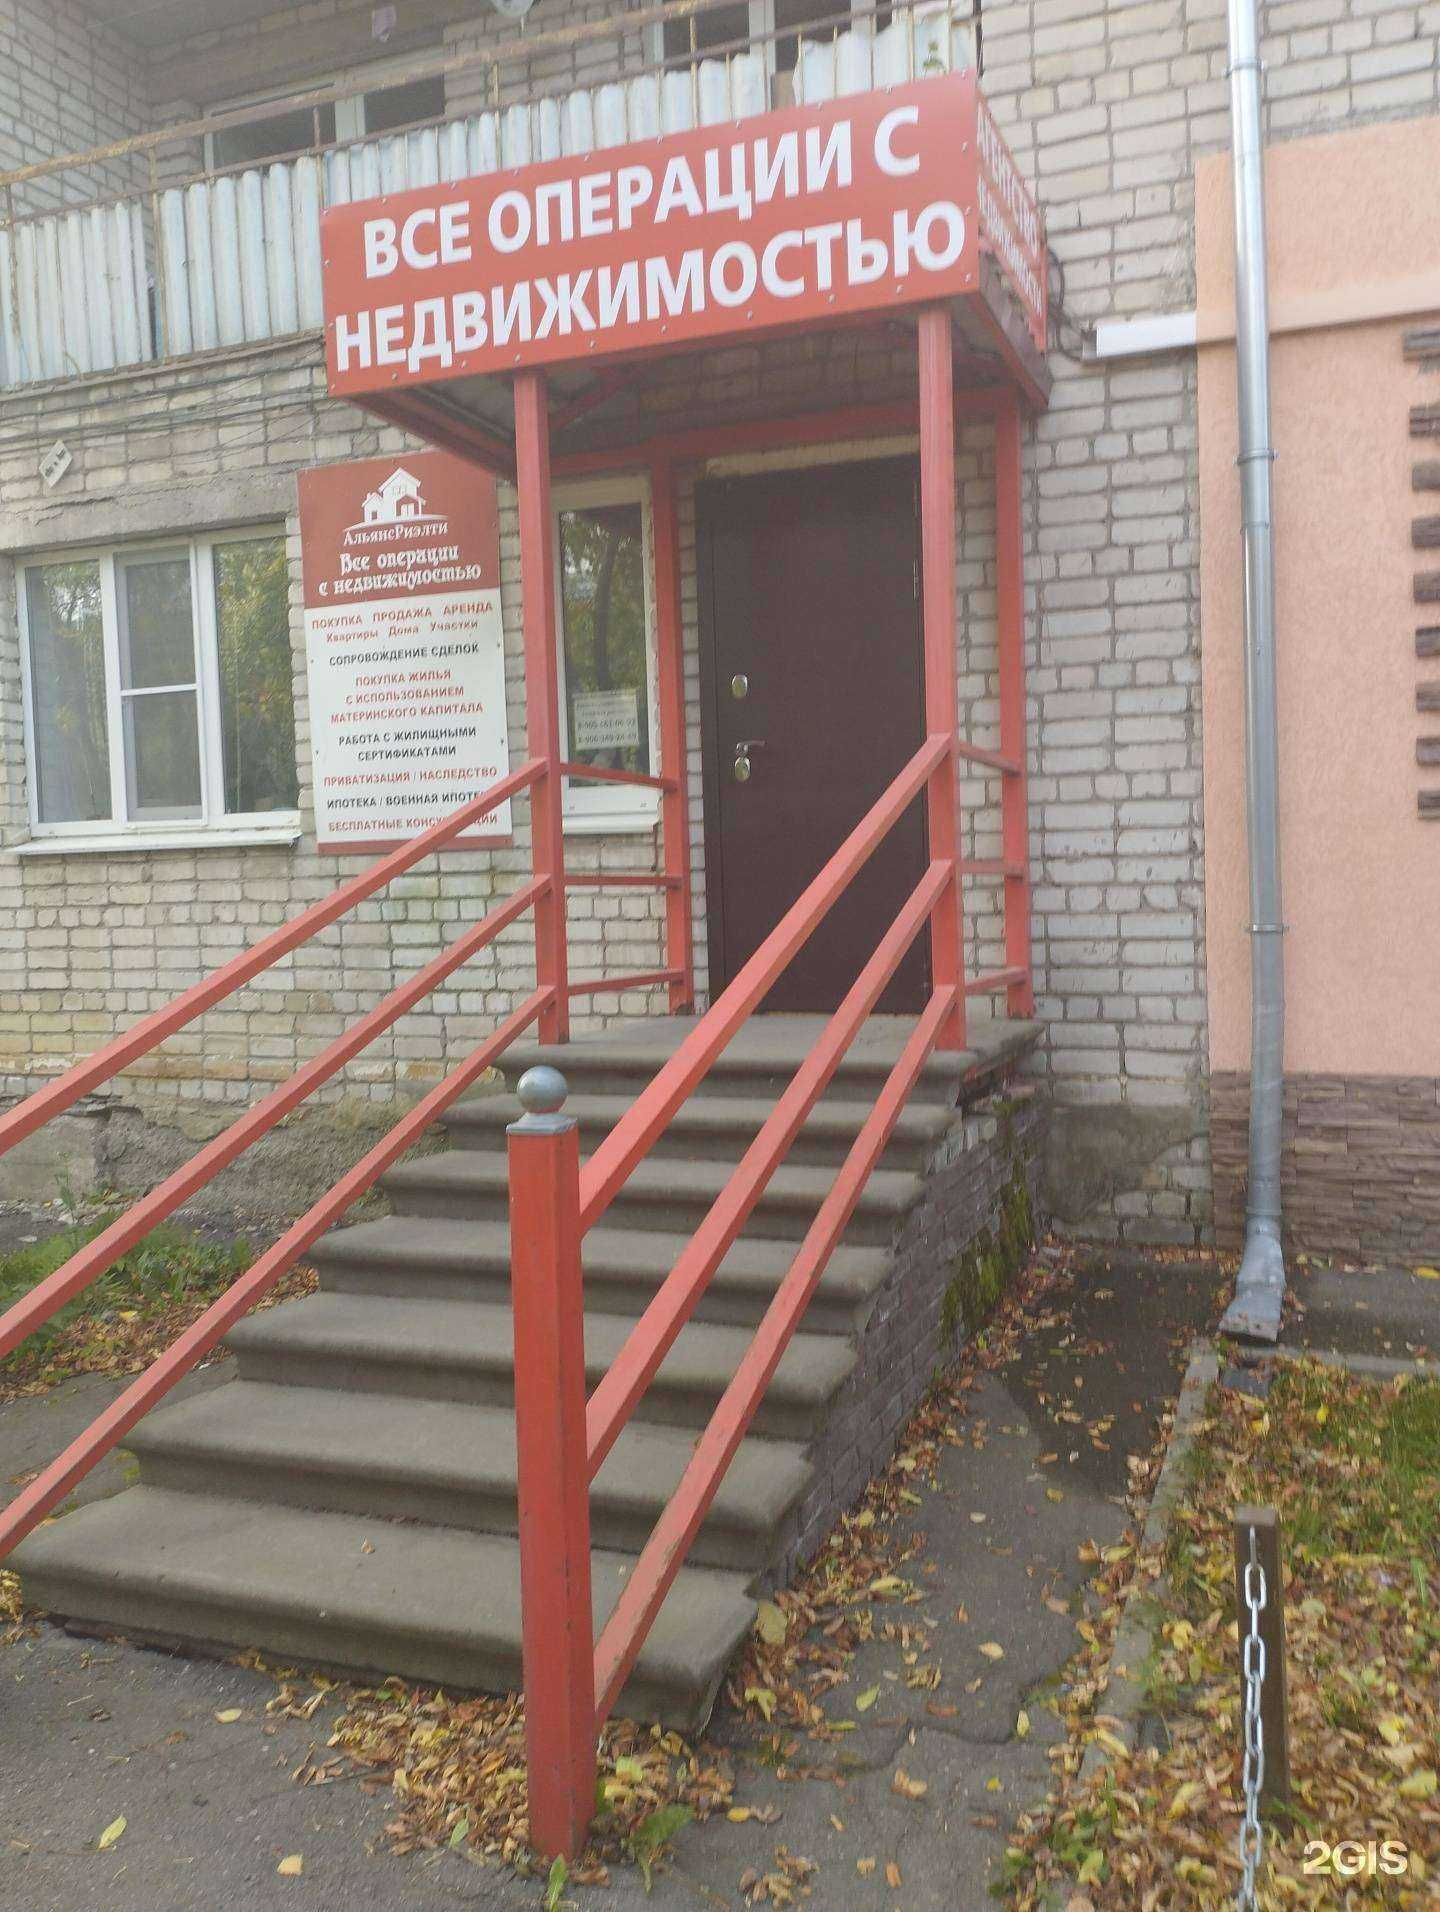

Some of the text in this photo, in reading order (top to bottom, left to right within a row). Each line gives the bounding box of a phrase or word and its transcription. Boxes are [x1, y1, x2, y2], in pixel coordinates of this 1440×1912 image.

[363, 105, 921, 279] ВСЕ ОПЕРАЦИИ С
[335, 200, 966, 373] НЕДВИЖИМОСТЬЮ
[343, 520, 449, 546] АльянсРиэлти
[339, 545, 459, 575] Все операции
[333, 564, 482, 595] недвижимостью
[312, 601, 494, 630] ПОКУПКА ПРОДАЖА АРЕНДА
[326, 621, 479, 643] Квартиры Дома Участки
[329, 642, 480, 666] СОПРОВОЖДЕНИЕ СДЕЛОК
[355, 668, 452, 687] ПОКУПКА ЖИЛЬЯ
[345, 686, 465, 705] С ИСПОЛЬЗОВАНИЕМ
[330, 702, 484, 725] МАТЕРИНСКОГО КАПИТАЛА
[339, 726, 477, 747] РАБОТА С ЖИЛИЩНЫМИ
[357, 746, 457, 762] СЕРТИФИКАТАМИ
[323, 771, 411, 788] ПРИВАТИЗАЦИЯ
[419, 766, 498, 782] НАСЛЕДСТВО
[326, 795, 377, 809] ИПОТЕКА
[386, 792, 439, 806] ВОЕННАЯ
[442, 790, 486, 802] ИПОТЕ
[328, 818, 401, 832] БЕСПЛАТНЫЕ
